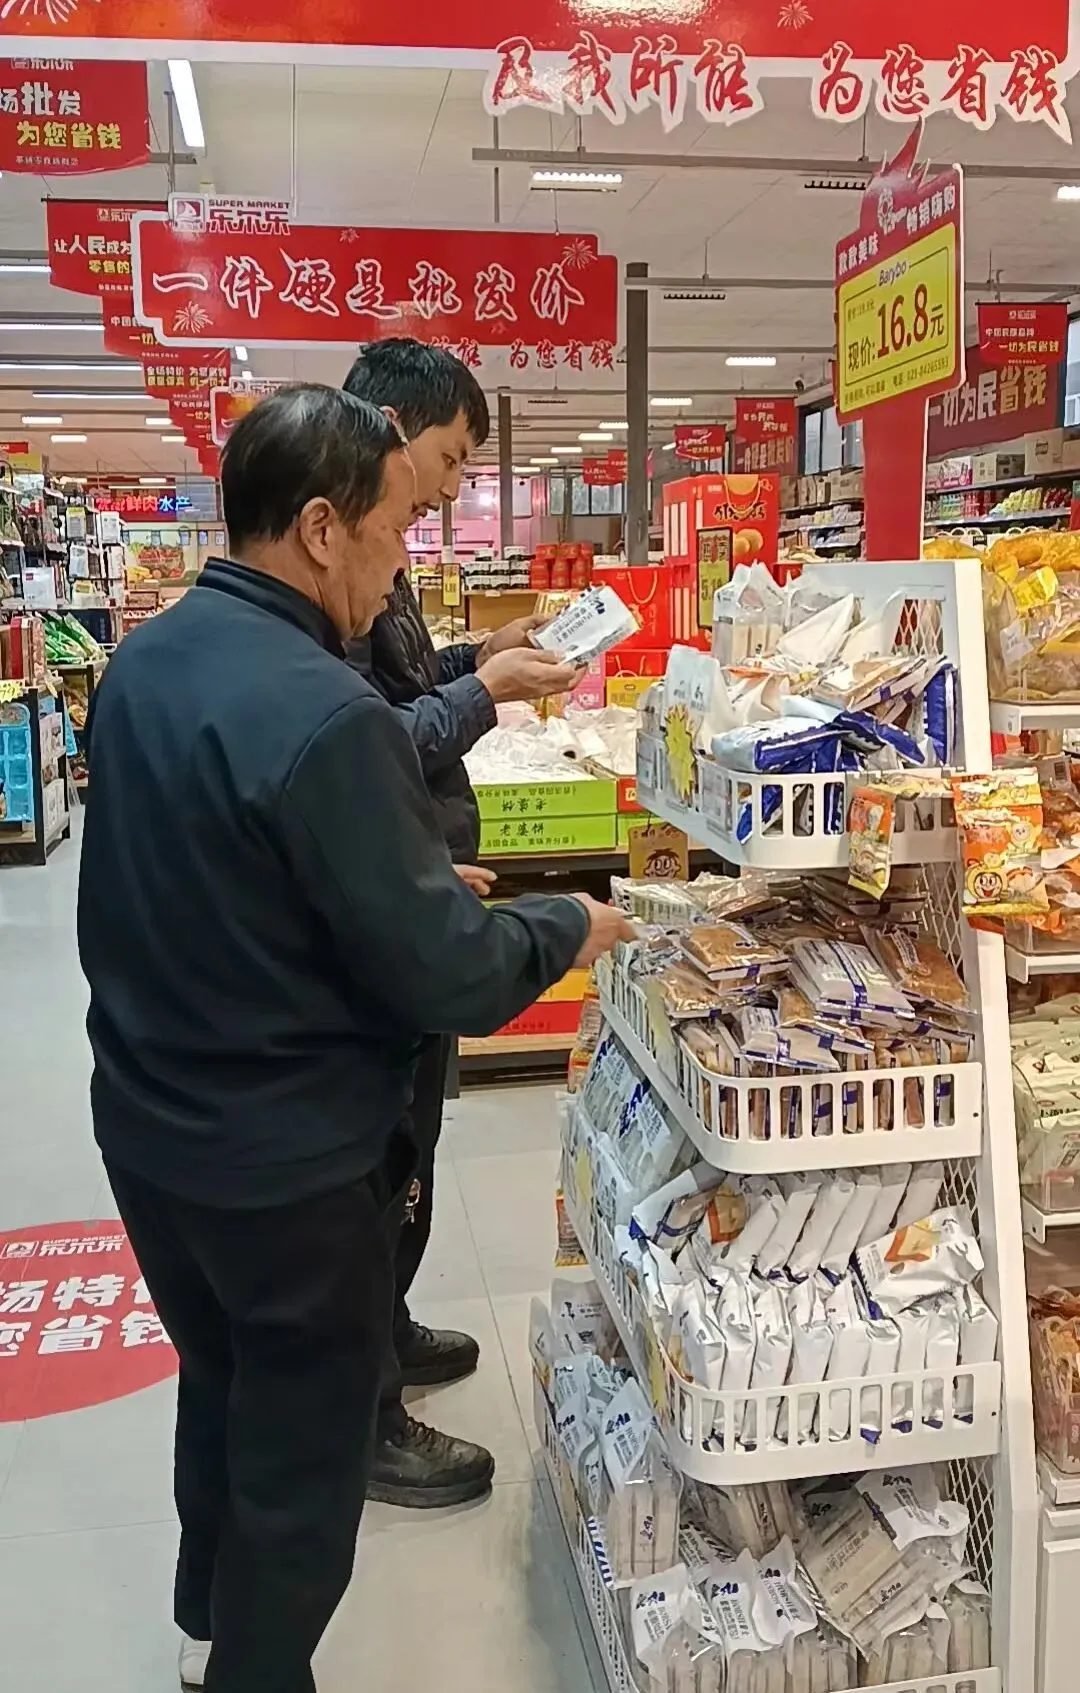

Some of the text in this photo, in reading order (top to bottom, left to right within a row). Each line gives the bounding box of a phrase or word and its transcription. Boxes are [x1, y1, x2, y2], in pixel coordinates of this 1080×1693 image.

[819, 43, 1061, 124] 为您省钱
[0, 82, 81, 115] 场批发
[17, 121, 121, 149] 为您省钱
[209, 199, 290, 209] SUPER MARKET
[209, 209, 291, 236] 乐尔乐
[510, 338, 614, 371] 为您省钱
[500, 822, 545, 837] 老婆饼
